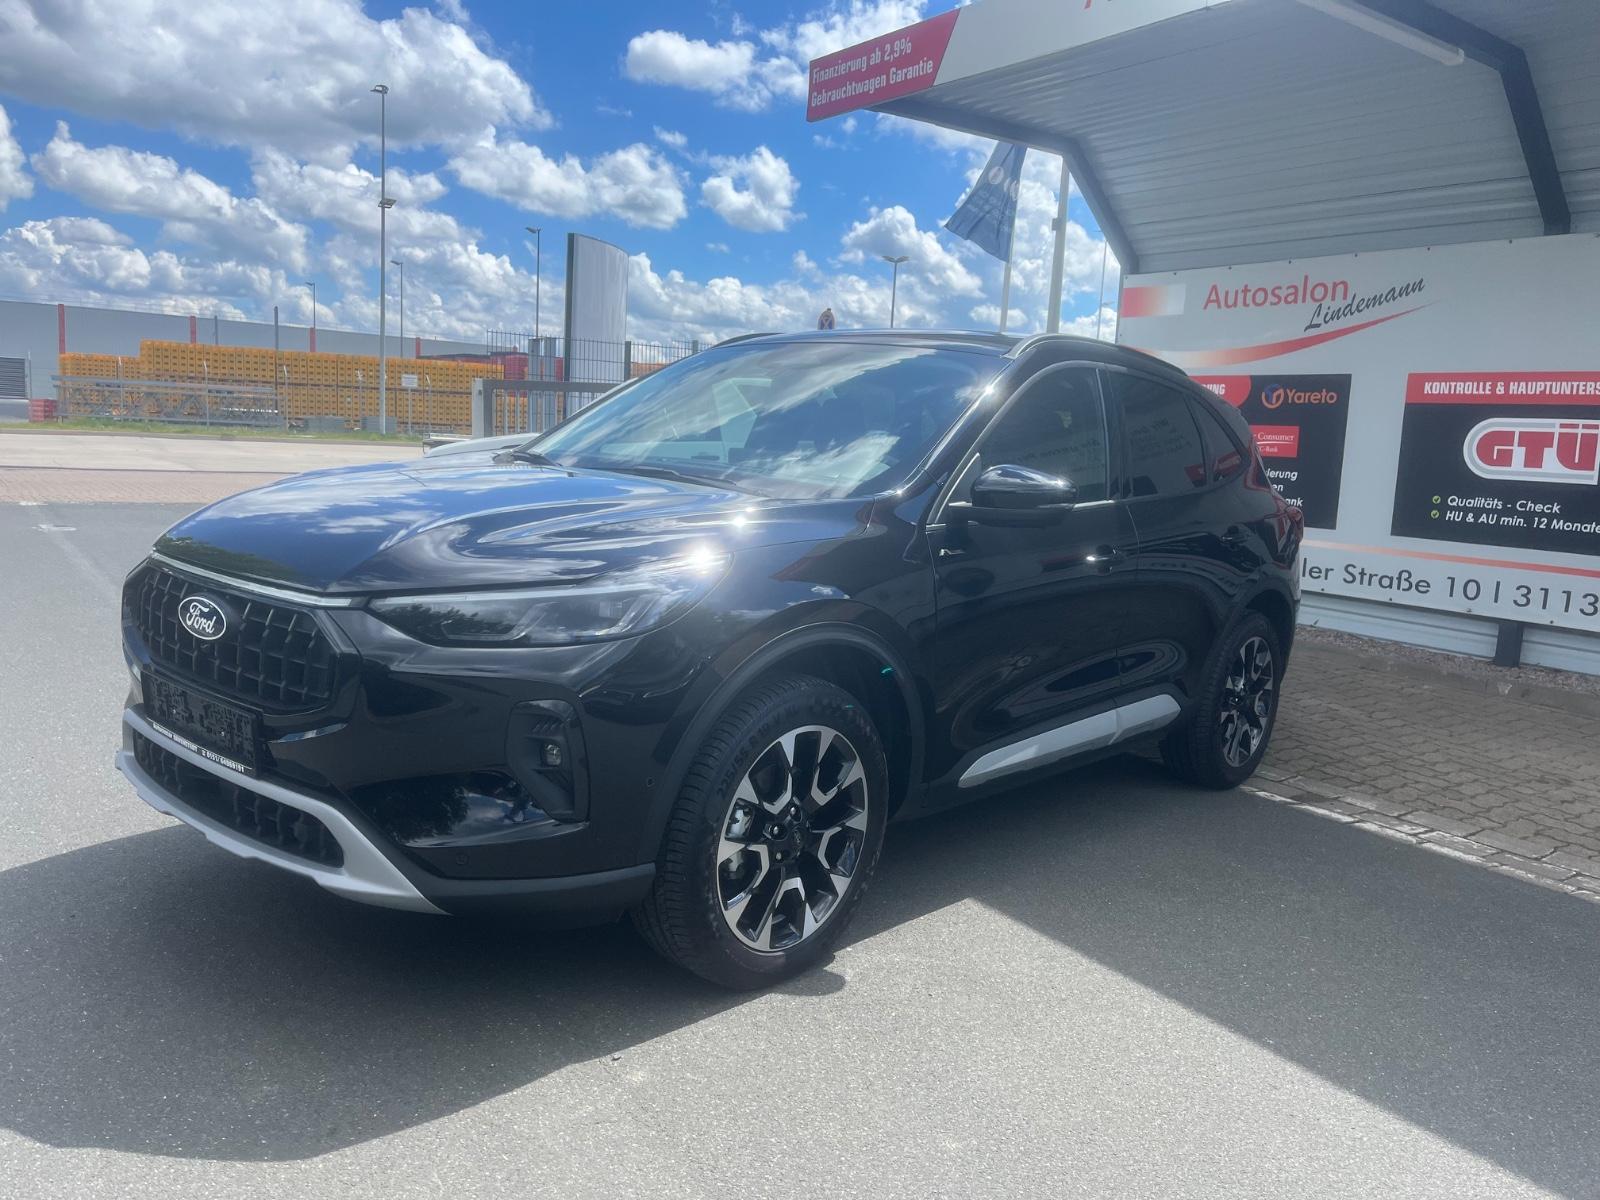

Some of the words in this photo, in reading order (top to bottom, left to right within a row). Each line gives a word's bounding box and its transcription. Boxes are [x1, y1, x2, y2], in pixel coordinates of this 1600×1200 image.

[812, 56, 867, 85] Finanzierung
[869, 47, 881, 66] ab
[884, 37, 912, 62] 2,9%
[811, 74, 887, 107] Gebrauchtwagen
[889, 57, 933, 84] Garantie
[1203, 275, 1349, 310] Autosalon
[1304, 278, 1425, 332] Lindemann
[1201, 384, 1225, 395] UNG
[1286, 388, 1337, 404] Yareto
[1424, 381, 1492, 395] KONTROLLE
[1495, 382, 1505, 395] &
[1257, 432, 1295, 441] Consumer
[1476, 423, 1600, 471] GTÜ
[1447, 496, 1503, 510] Qualitäts
[1516, 500, 1561, 514] Check
[1445, 510, 1463, 522] HU
[1466, 513, 1475, 523] &
[1478, 513, 1497, 525] AU
[1500, 515, 1527, 527] min.
[1533, 517, 1548, 529] 12
[1551, 519, 1600, 534] Monate
[1343, 564, 1431, 594] Straße
[1447, 576, 1481, 601] 10
[1513, 584, 1600, 616] 3113
[186, 602, 217, 634] Ford
